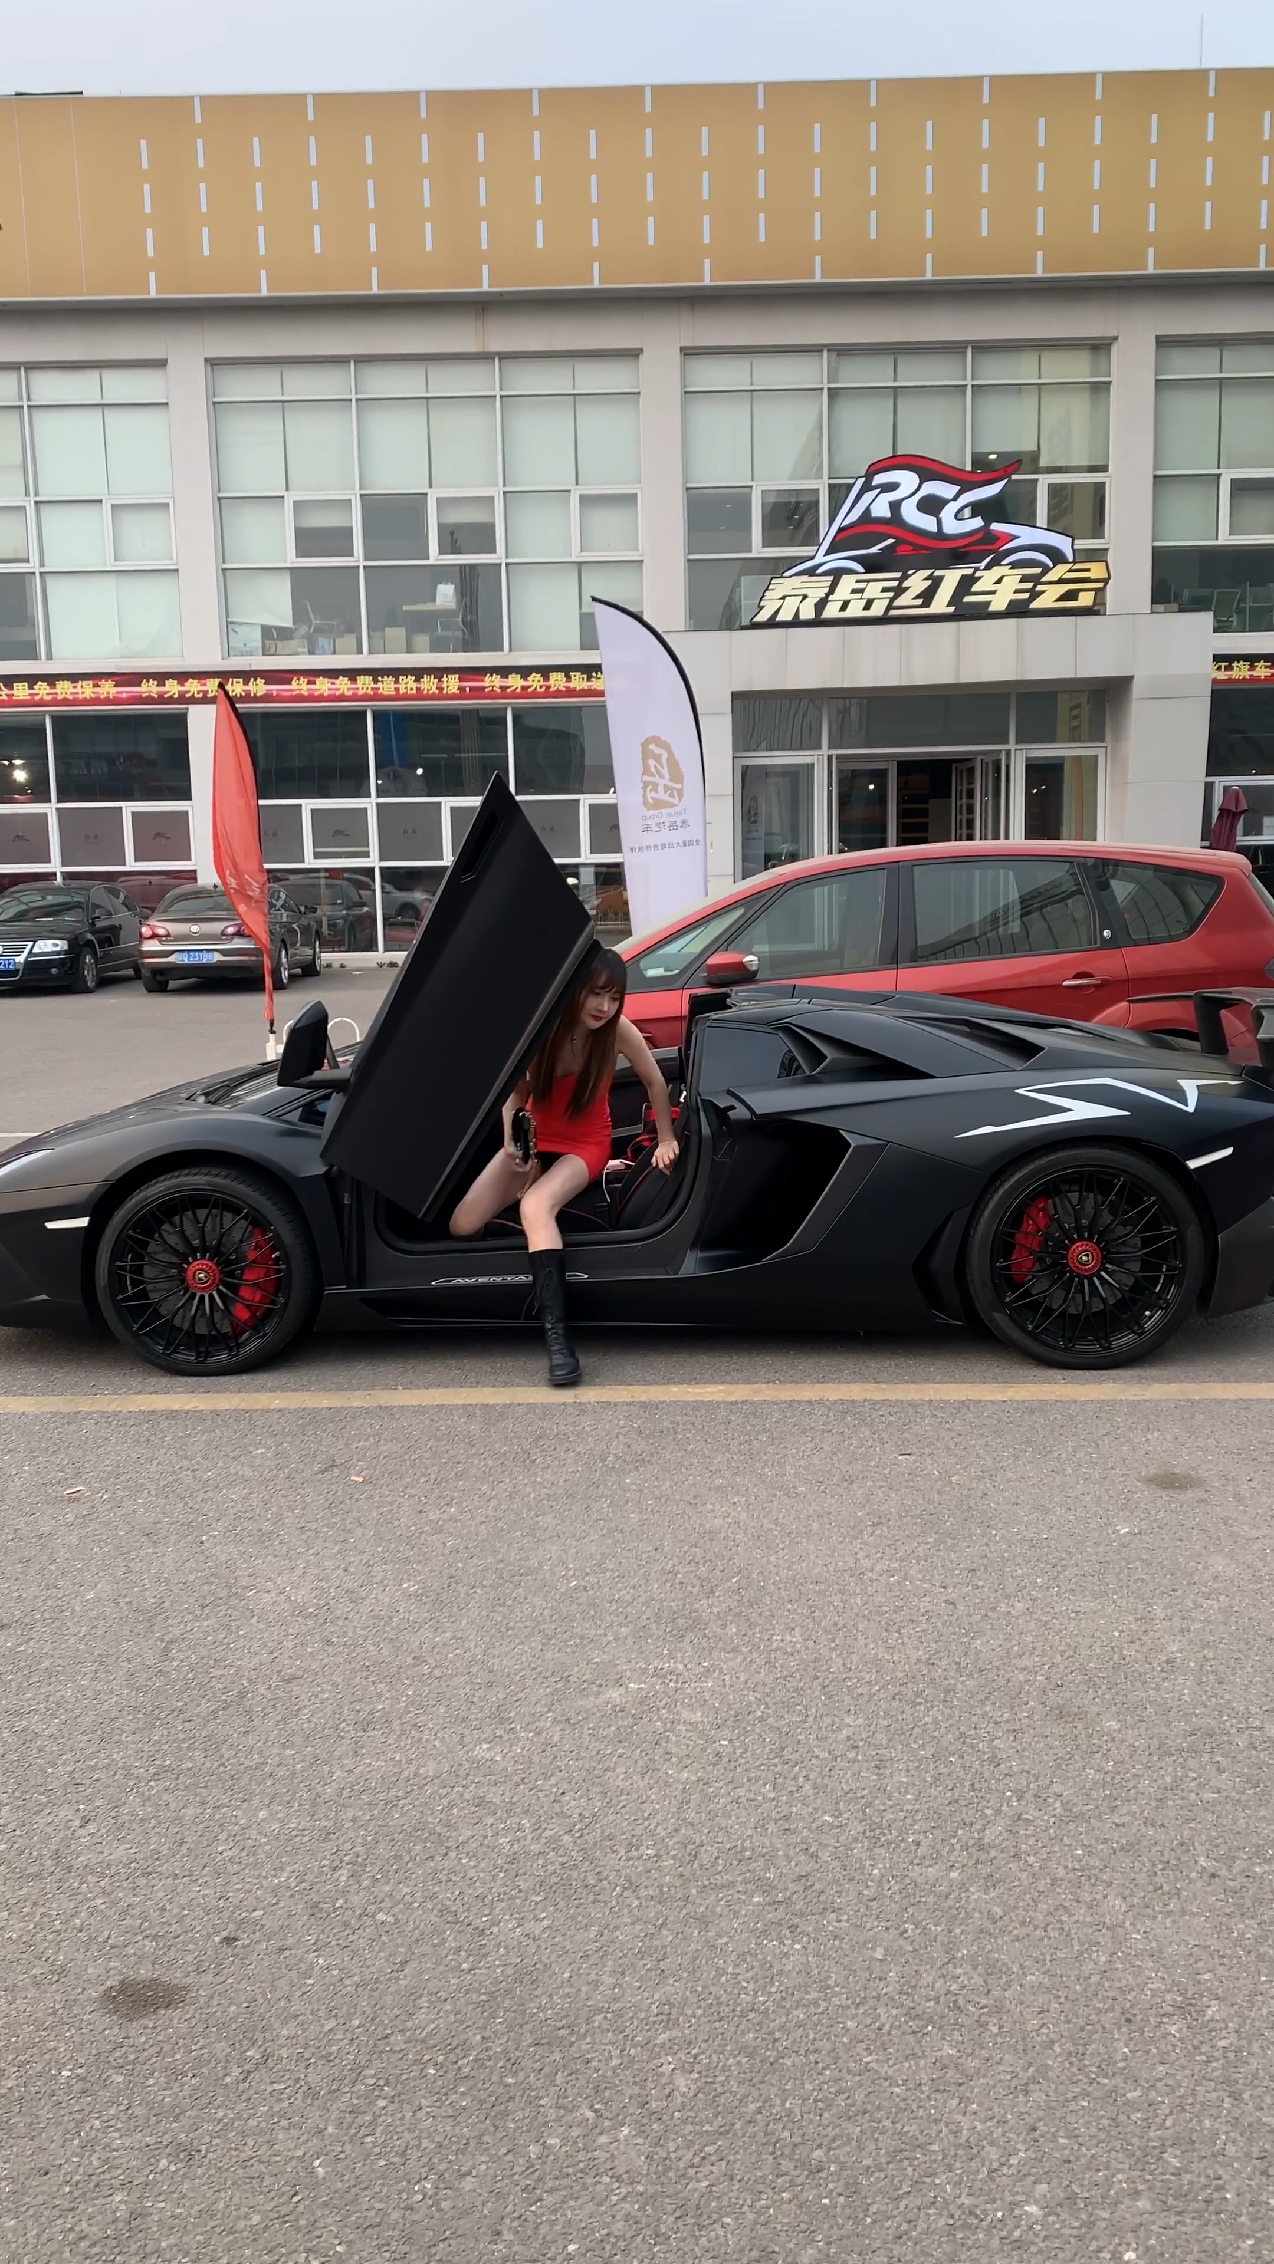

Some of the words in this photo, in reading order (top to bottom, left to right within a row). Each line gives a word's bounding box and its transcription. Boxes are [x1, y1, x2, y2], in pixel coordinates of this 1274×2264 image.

[751, 562, 1109, 622] 泰岳红车会
